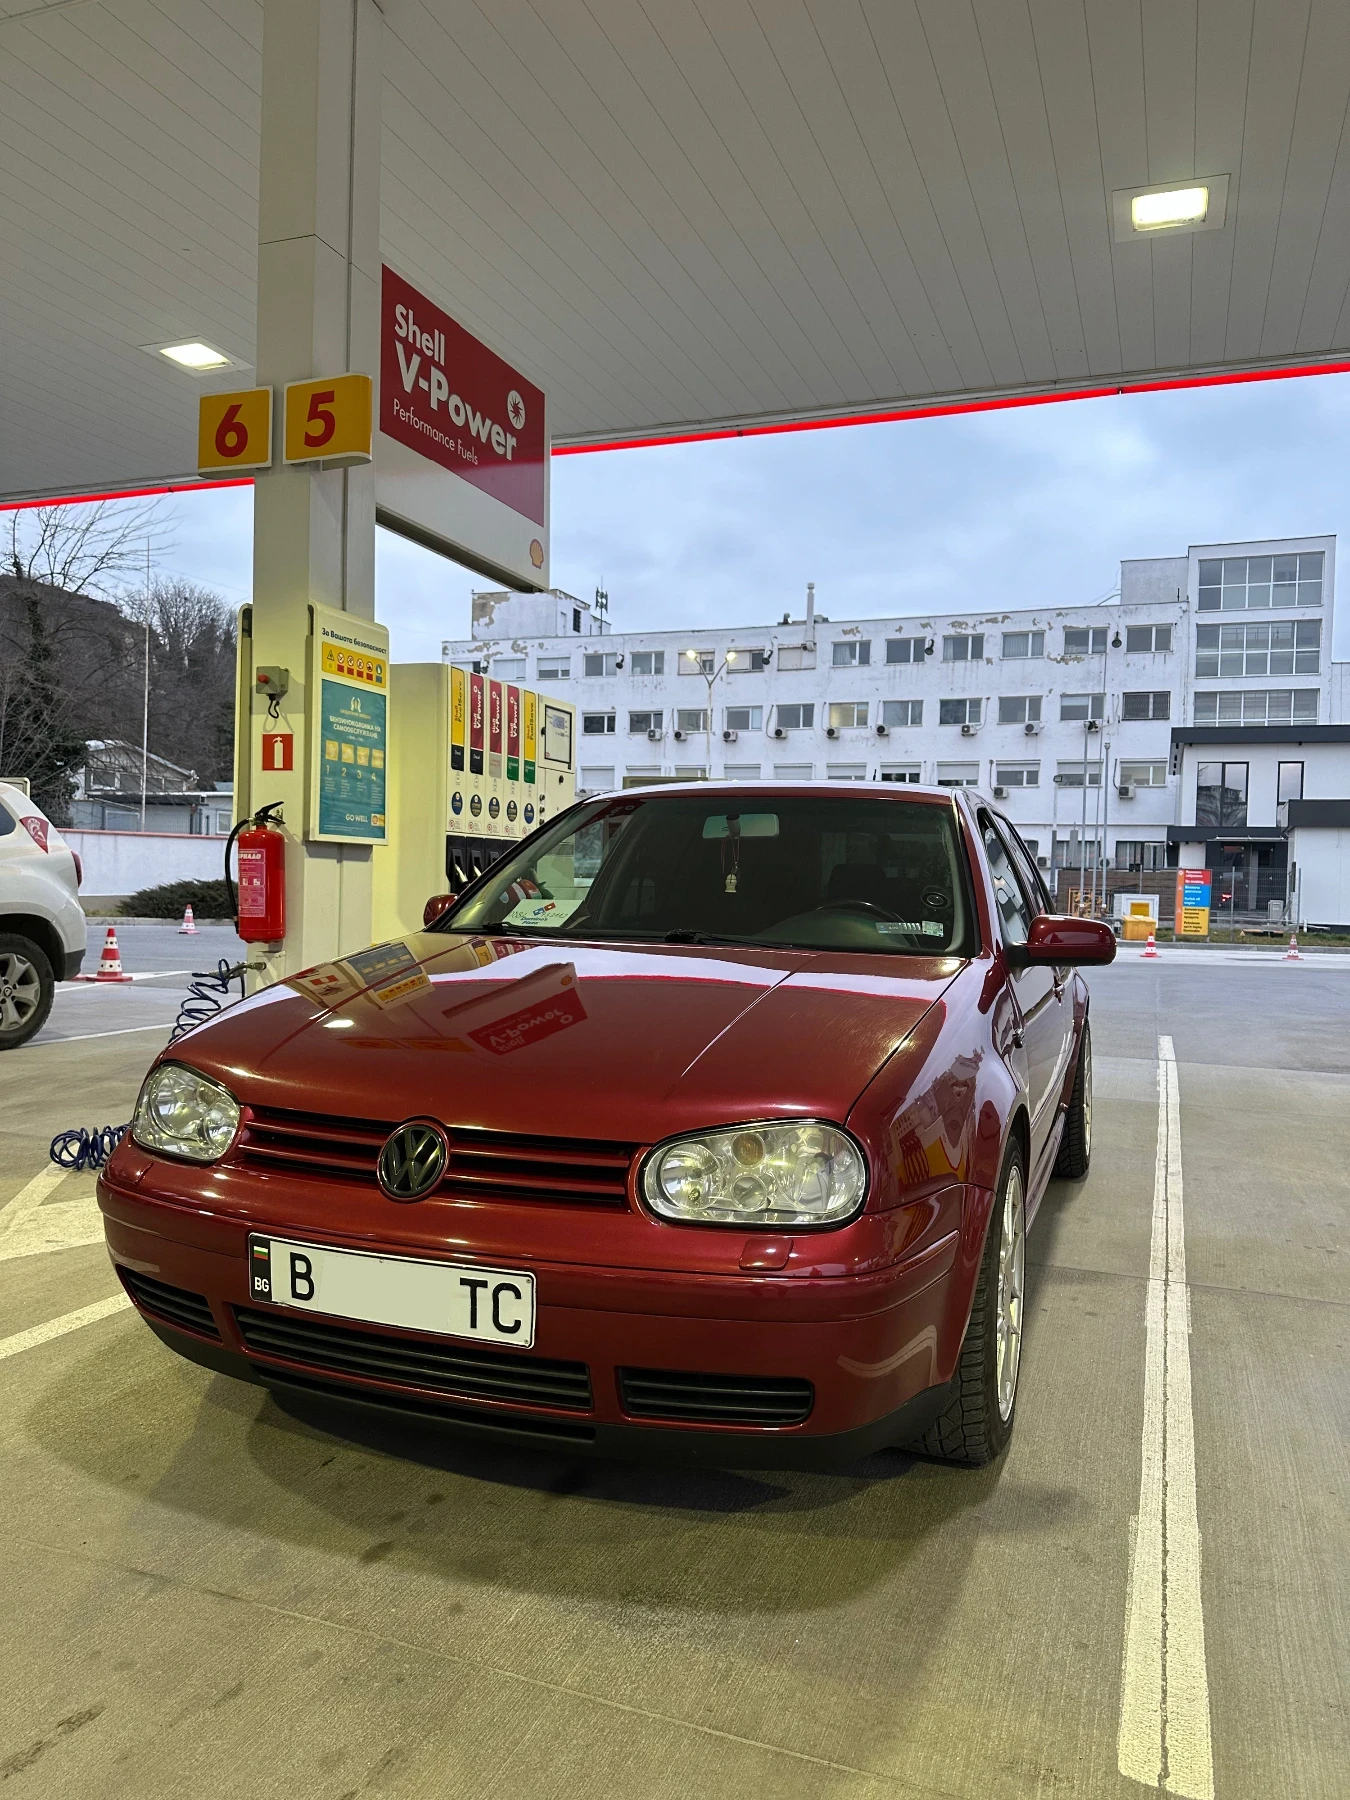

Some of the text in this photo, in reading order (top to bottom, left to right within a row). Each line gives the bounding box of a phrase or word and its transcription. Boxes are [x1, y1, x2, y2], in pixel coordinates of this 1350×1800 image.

[395, 303, 446, 366] Shell
[304, 390, 336, 448] 5
[394, 339, 517, 461] V-Power
[215, 404, 249, 458] 6
[393, 398, 479, 467] Performance Fuels
[322, 627, 387, 655] За Вашата безопасност
[341, 767, 347, 777] 2
[356, 769, 362, 779] 3
[371, 772, 377, 781] 4
[345, 813, 369, 823] GO WELL
[254, 1276, 270, 1292] BG
[289, 1252, 522, 1334] B TC
